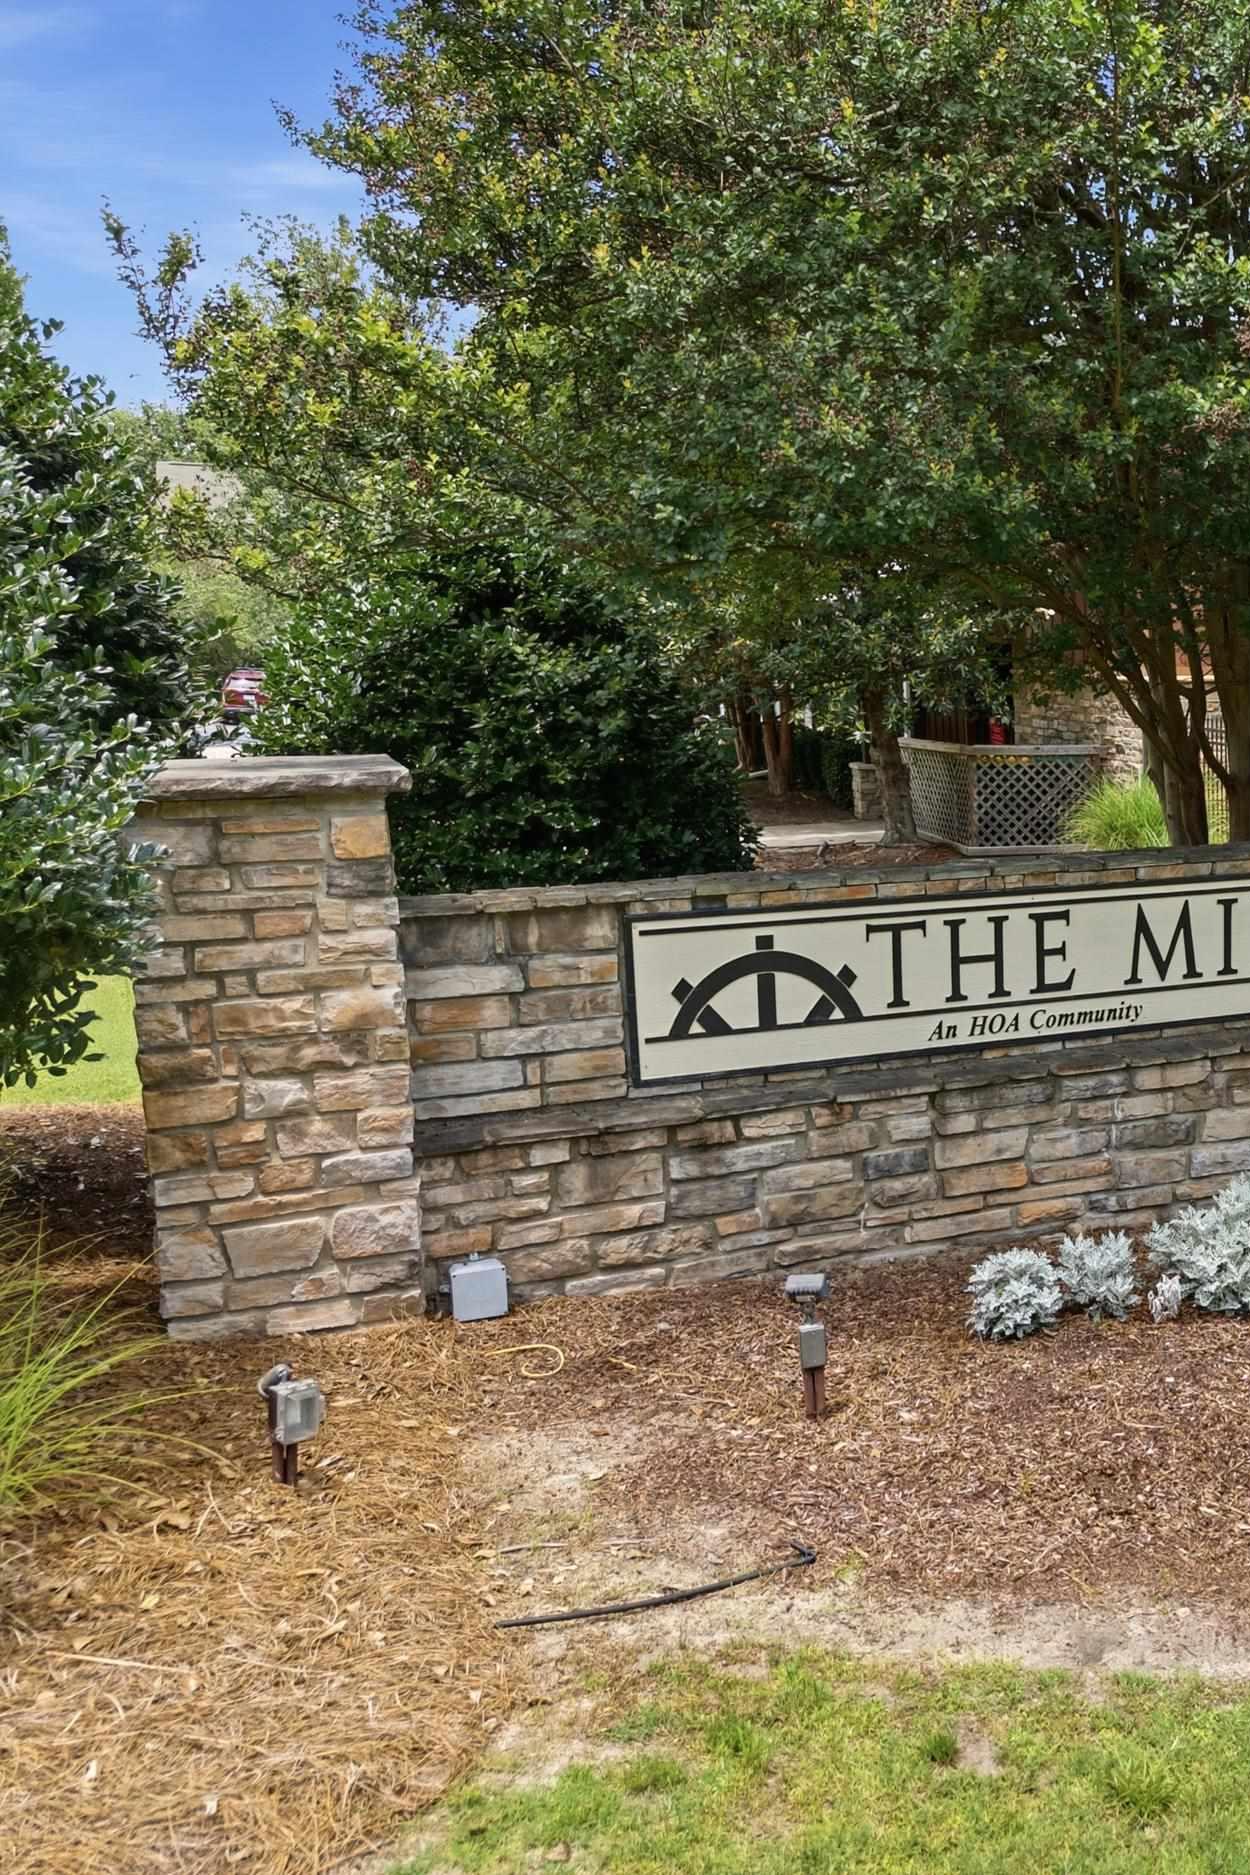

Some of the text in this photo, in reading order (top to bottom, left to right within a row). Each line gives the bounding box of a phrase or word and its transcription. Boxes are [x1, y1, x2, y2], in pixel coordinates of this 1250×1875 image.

[865, 908, 1077, 1009] THE
[927, 1001, 1144, 1042] An HOA Community
